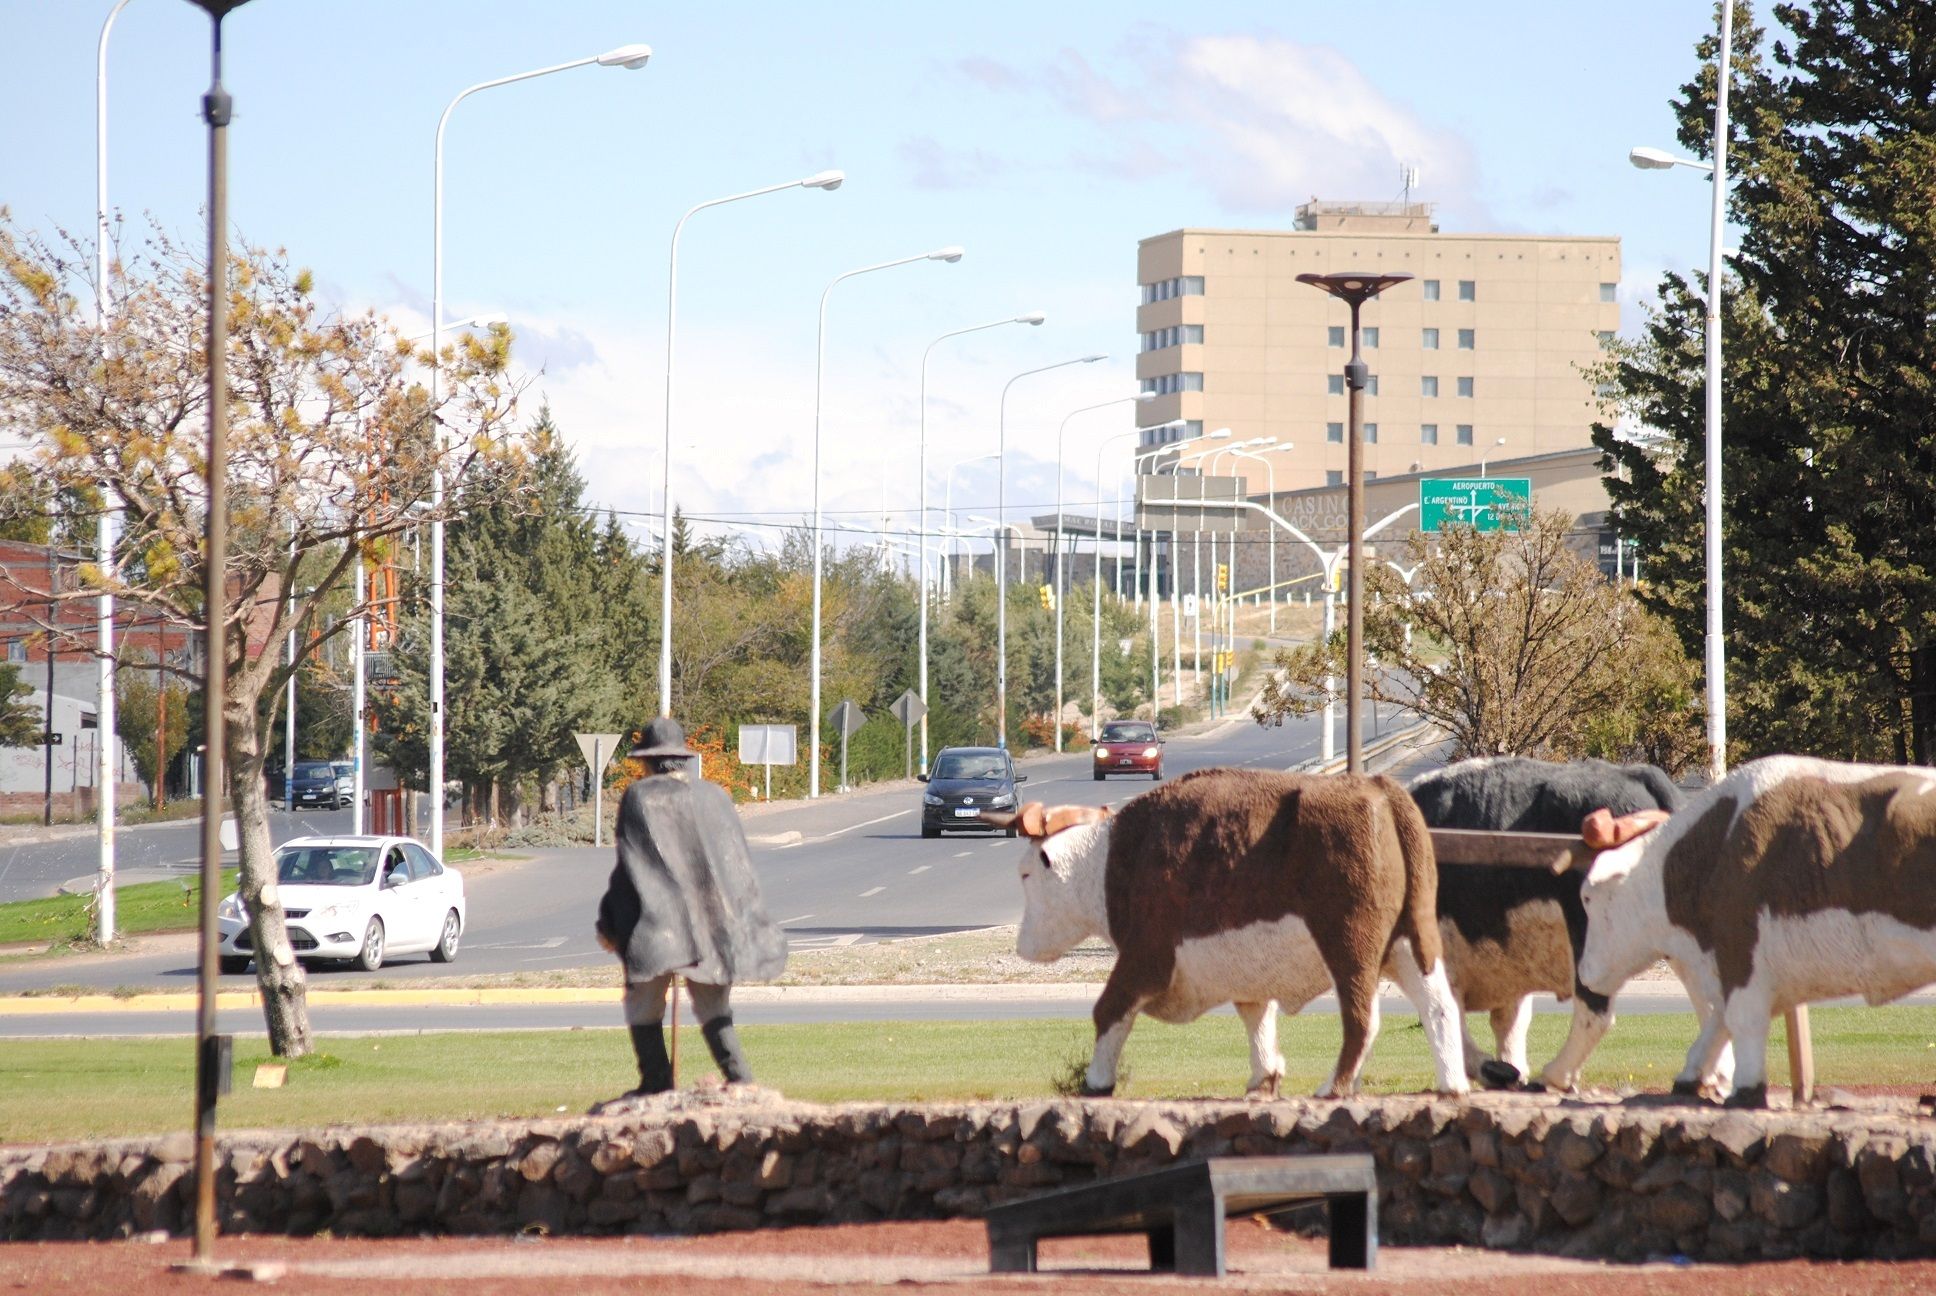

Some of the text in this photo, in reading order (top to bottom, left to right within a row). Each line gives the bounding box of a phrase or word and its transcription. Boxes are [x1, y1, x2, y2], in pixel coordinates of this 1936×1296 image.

[1452, 482, 1495, 490] AEROPUERTO
[1431, 496, 1468, 504] ARGENTINO
[1084, 519, 1114, 528] ROAL
[1323, 514, 1369, 529] GOD
